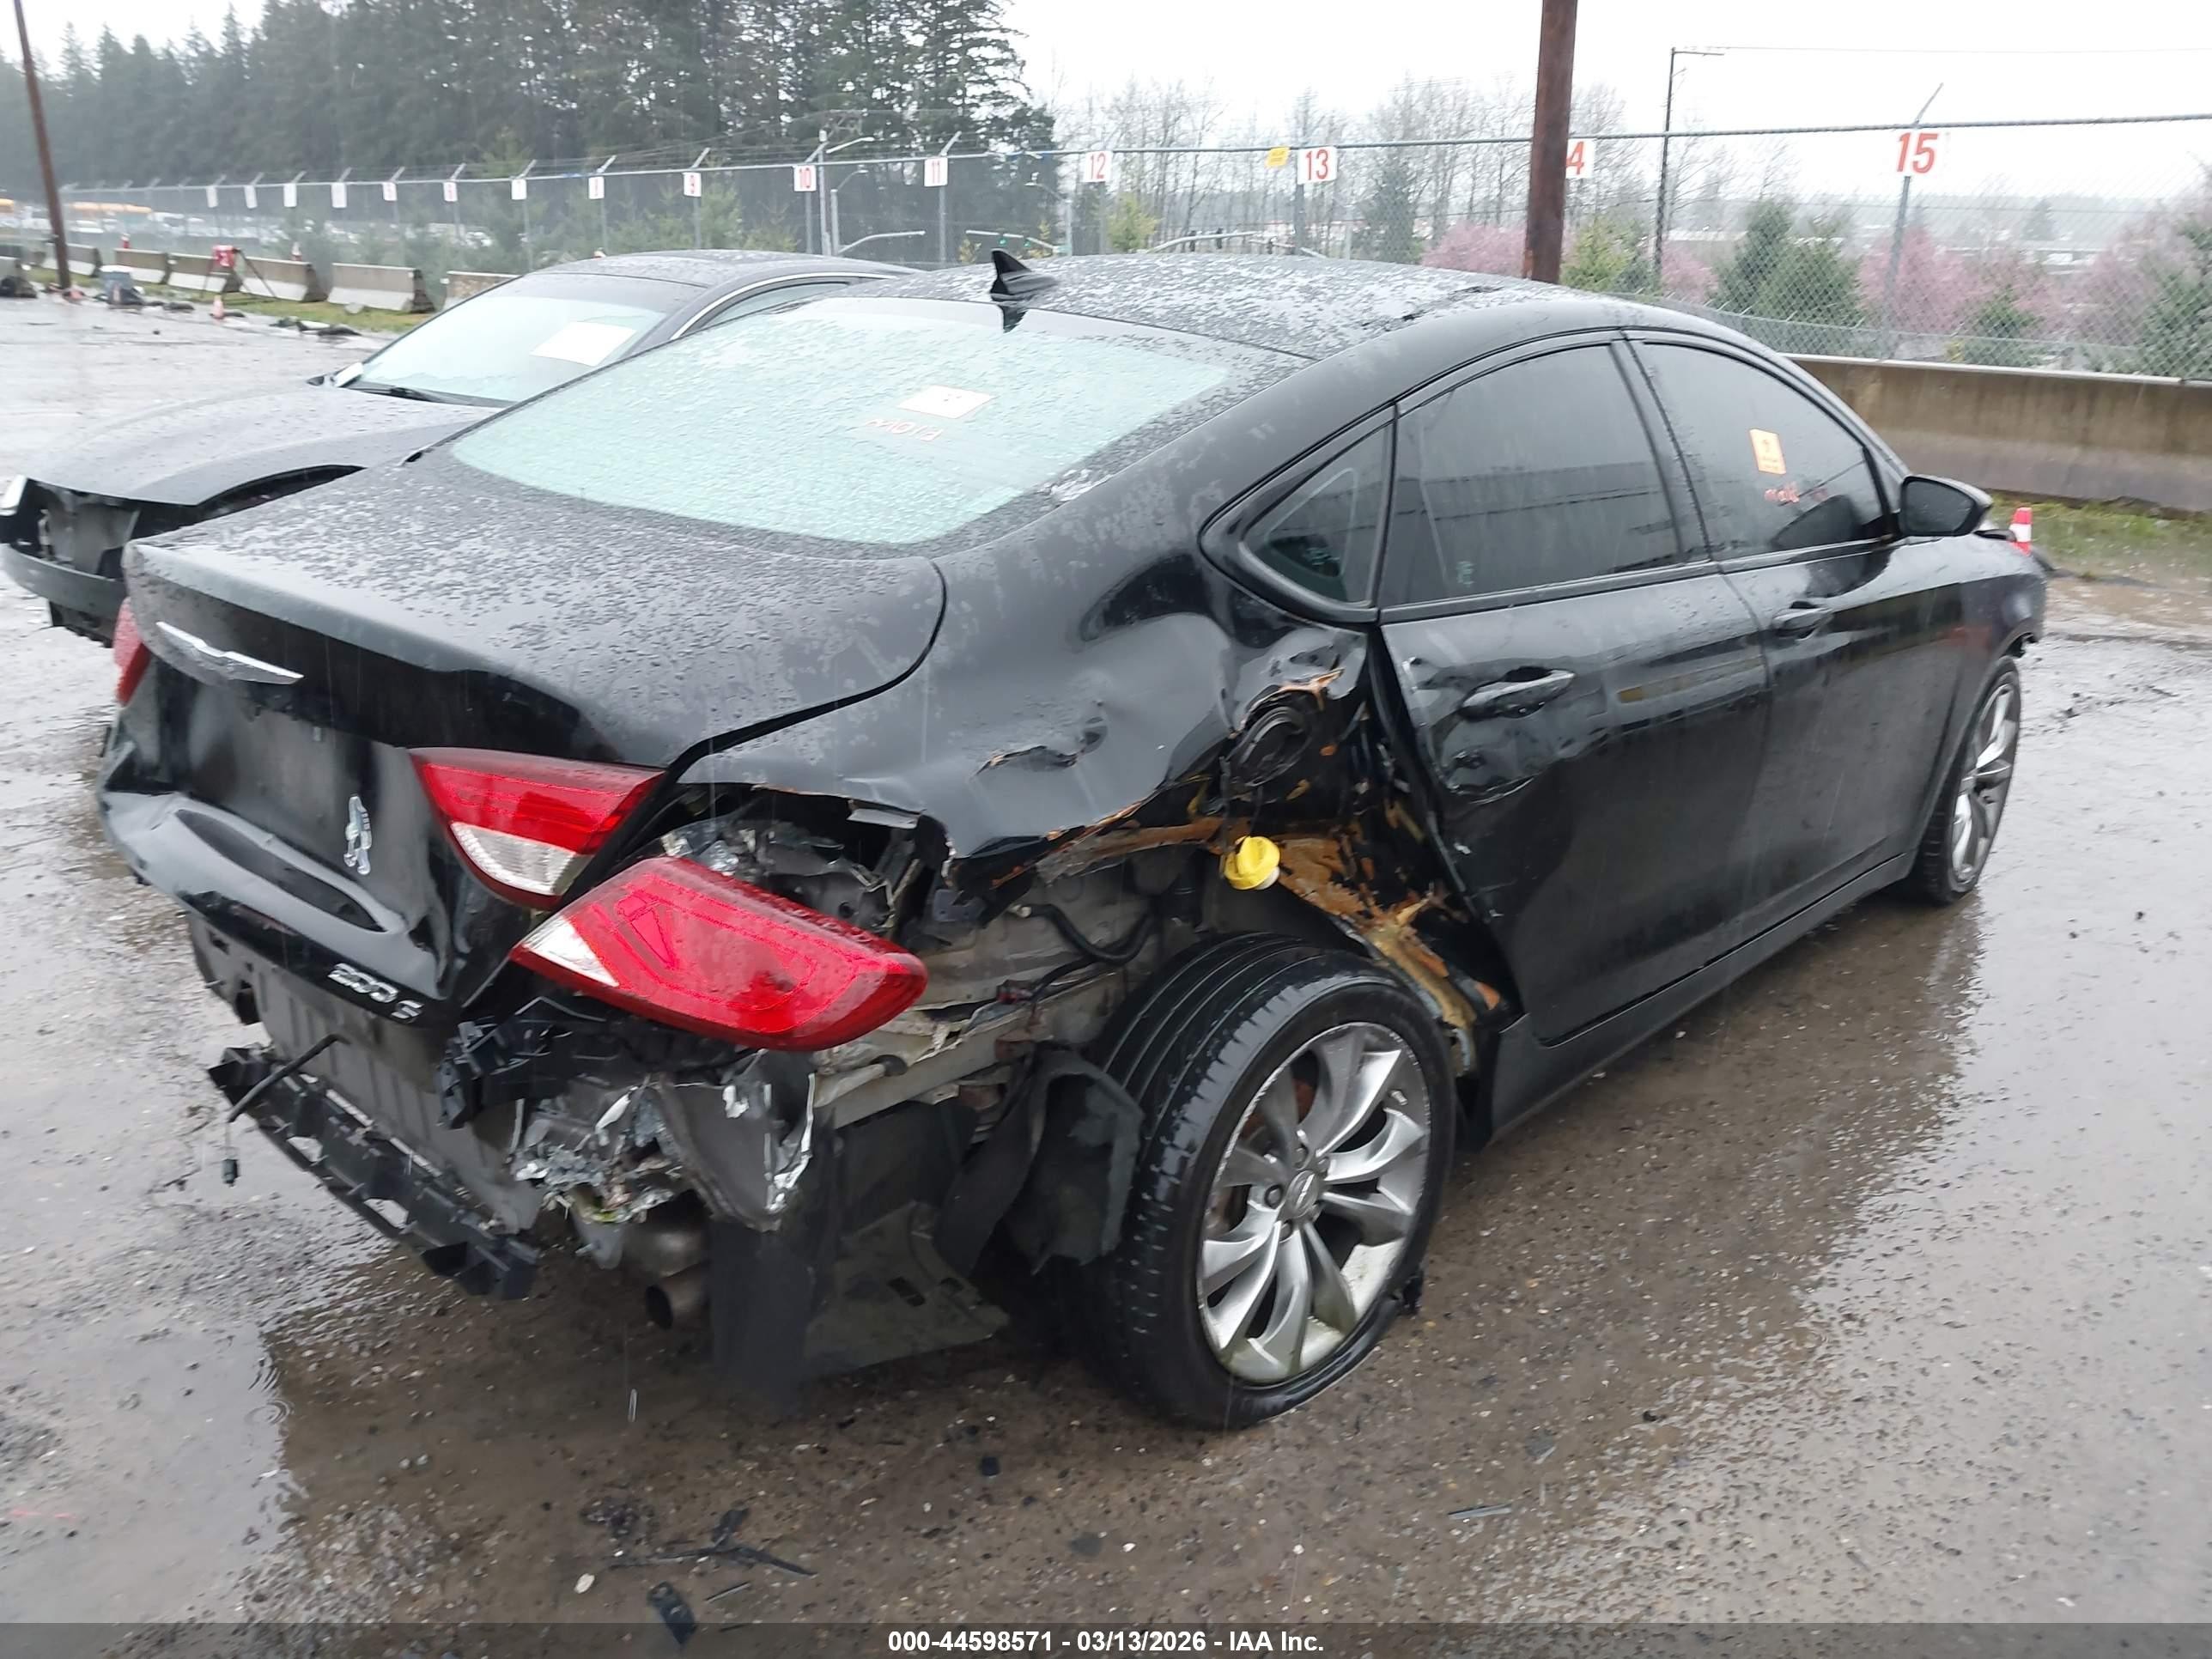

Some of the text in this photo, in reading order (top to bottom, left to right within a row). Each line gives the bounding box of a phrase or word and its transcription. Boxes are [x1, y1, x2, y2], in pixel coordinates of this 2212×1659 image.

[1090, 152, 1106, 179] 12
[1305, 149, 1328, 181] 13
[1566, 141, 1584, 175] 4
[1897, 131, 1939, 173] 15
[798, 167, 812, 189] 10
[931, 160, 941, 184] 11
[327, 963, 424, 1023] 200 S
